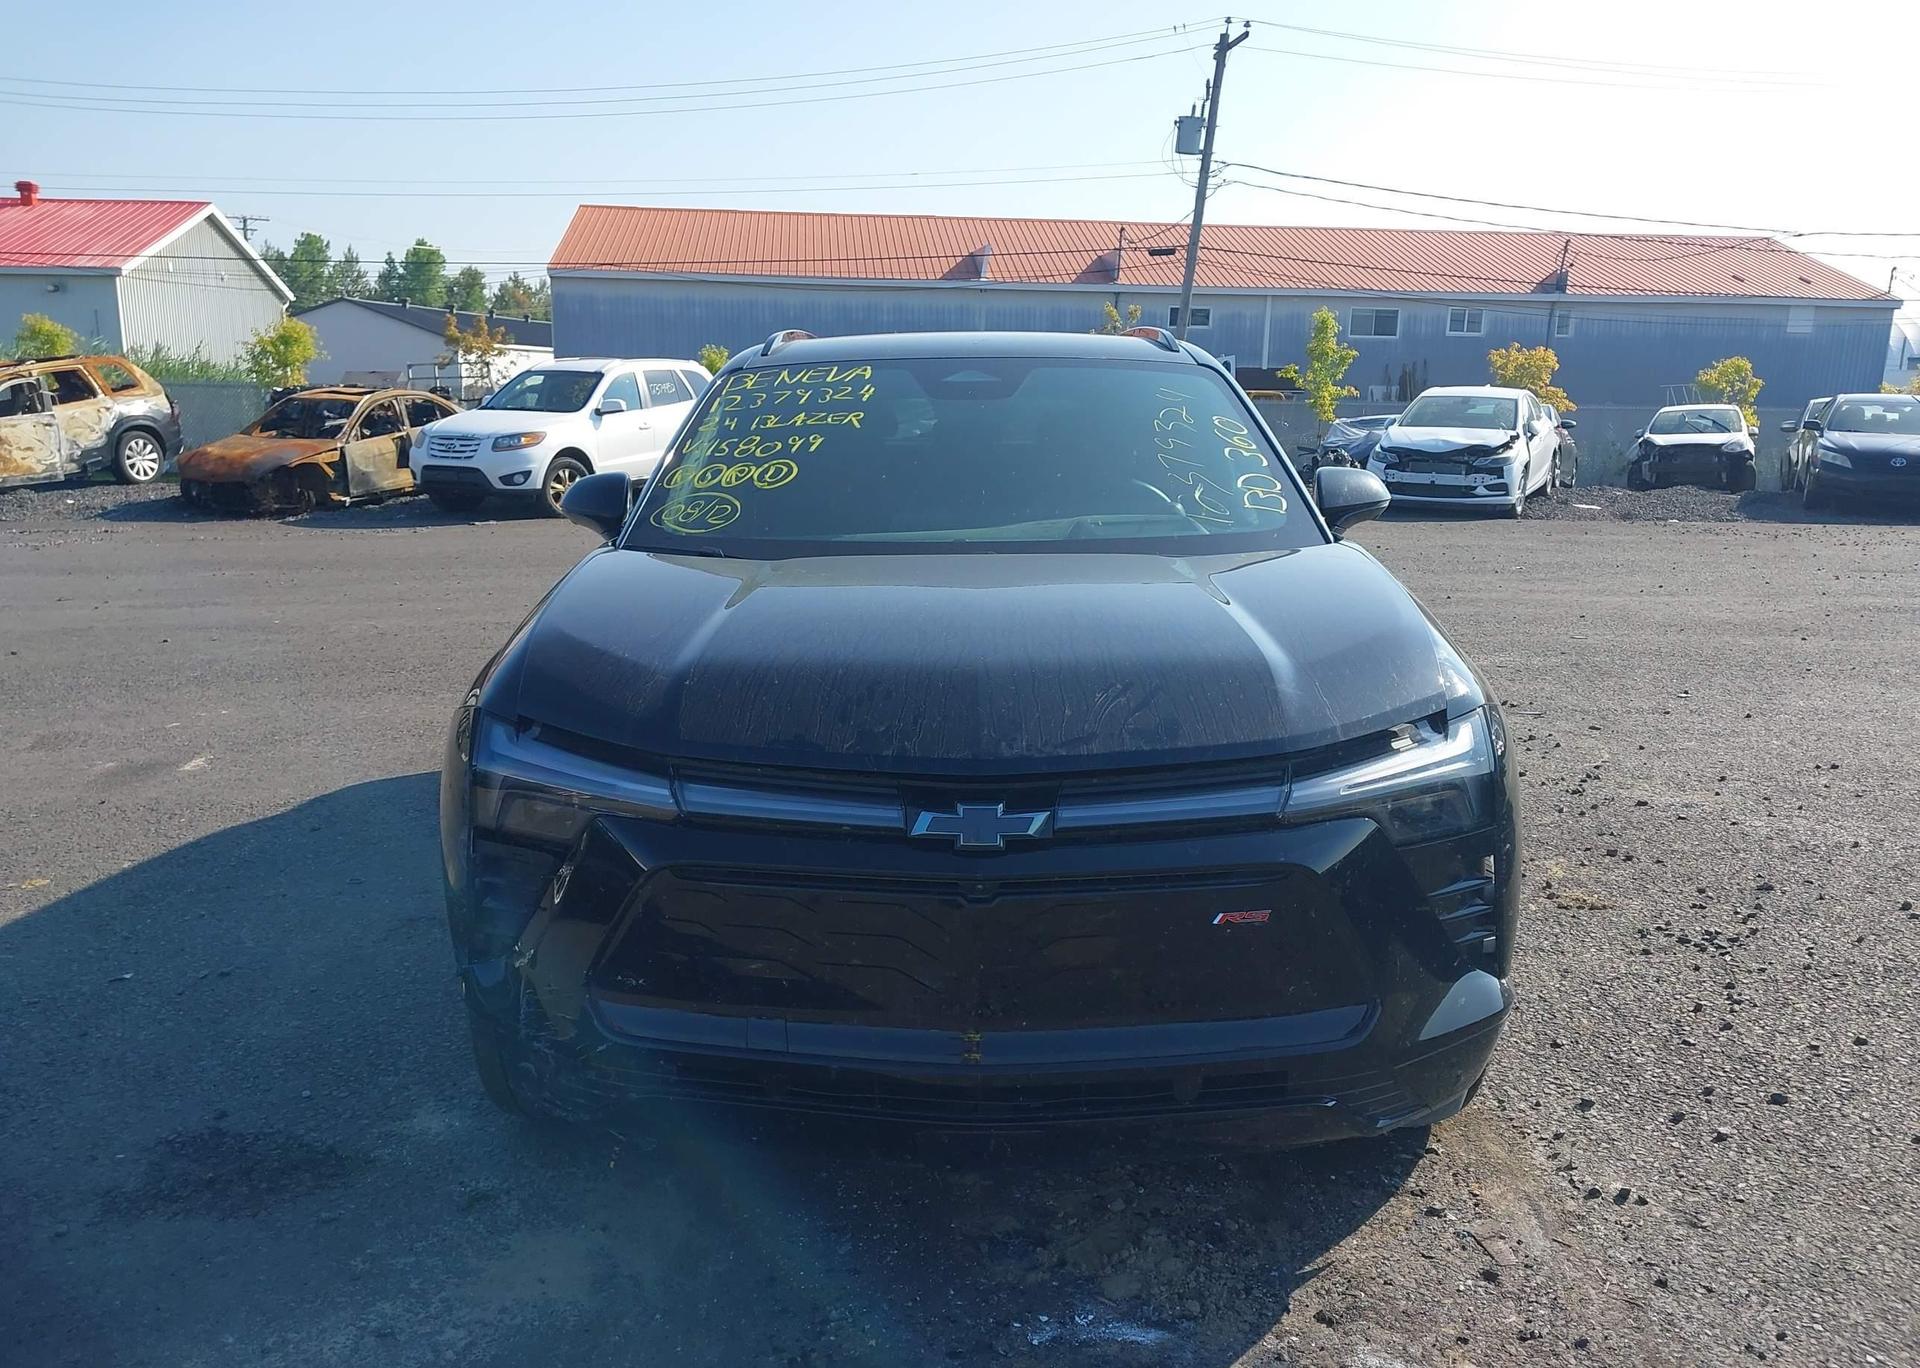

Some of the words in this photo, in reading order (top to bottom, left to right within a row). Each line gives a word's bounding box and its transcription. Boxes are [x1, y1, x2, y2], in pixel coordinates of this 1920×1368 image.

[721, 365, 873, 396] BENEVA
[710, 384, 876, 413] 12379324
[750, 411, 864, 431] BLAZER
[1212, 415, 1269, 467] 360
[1217, 910, 1272, 925] RS
